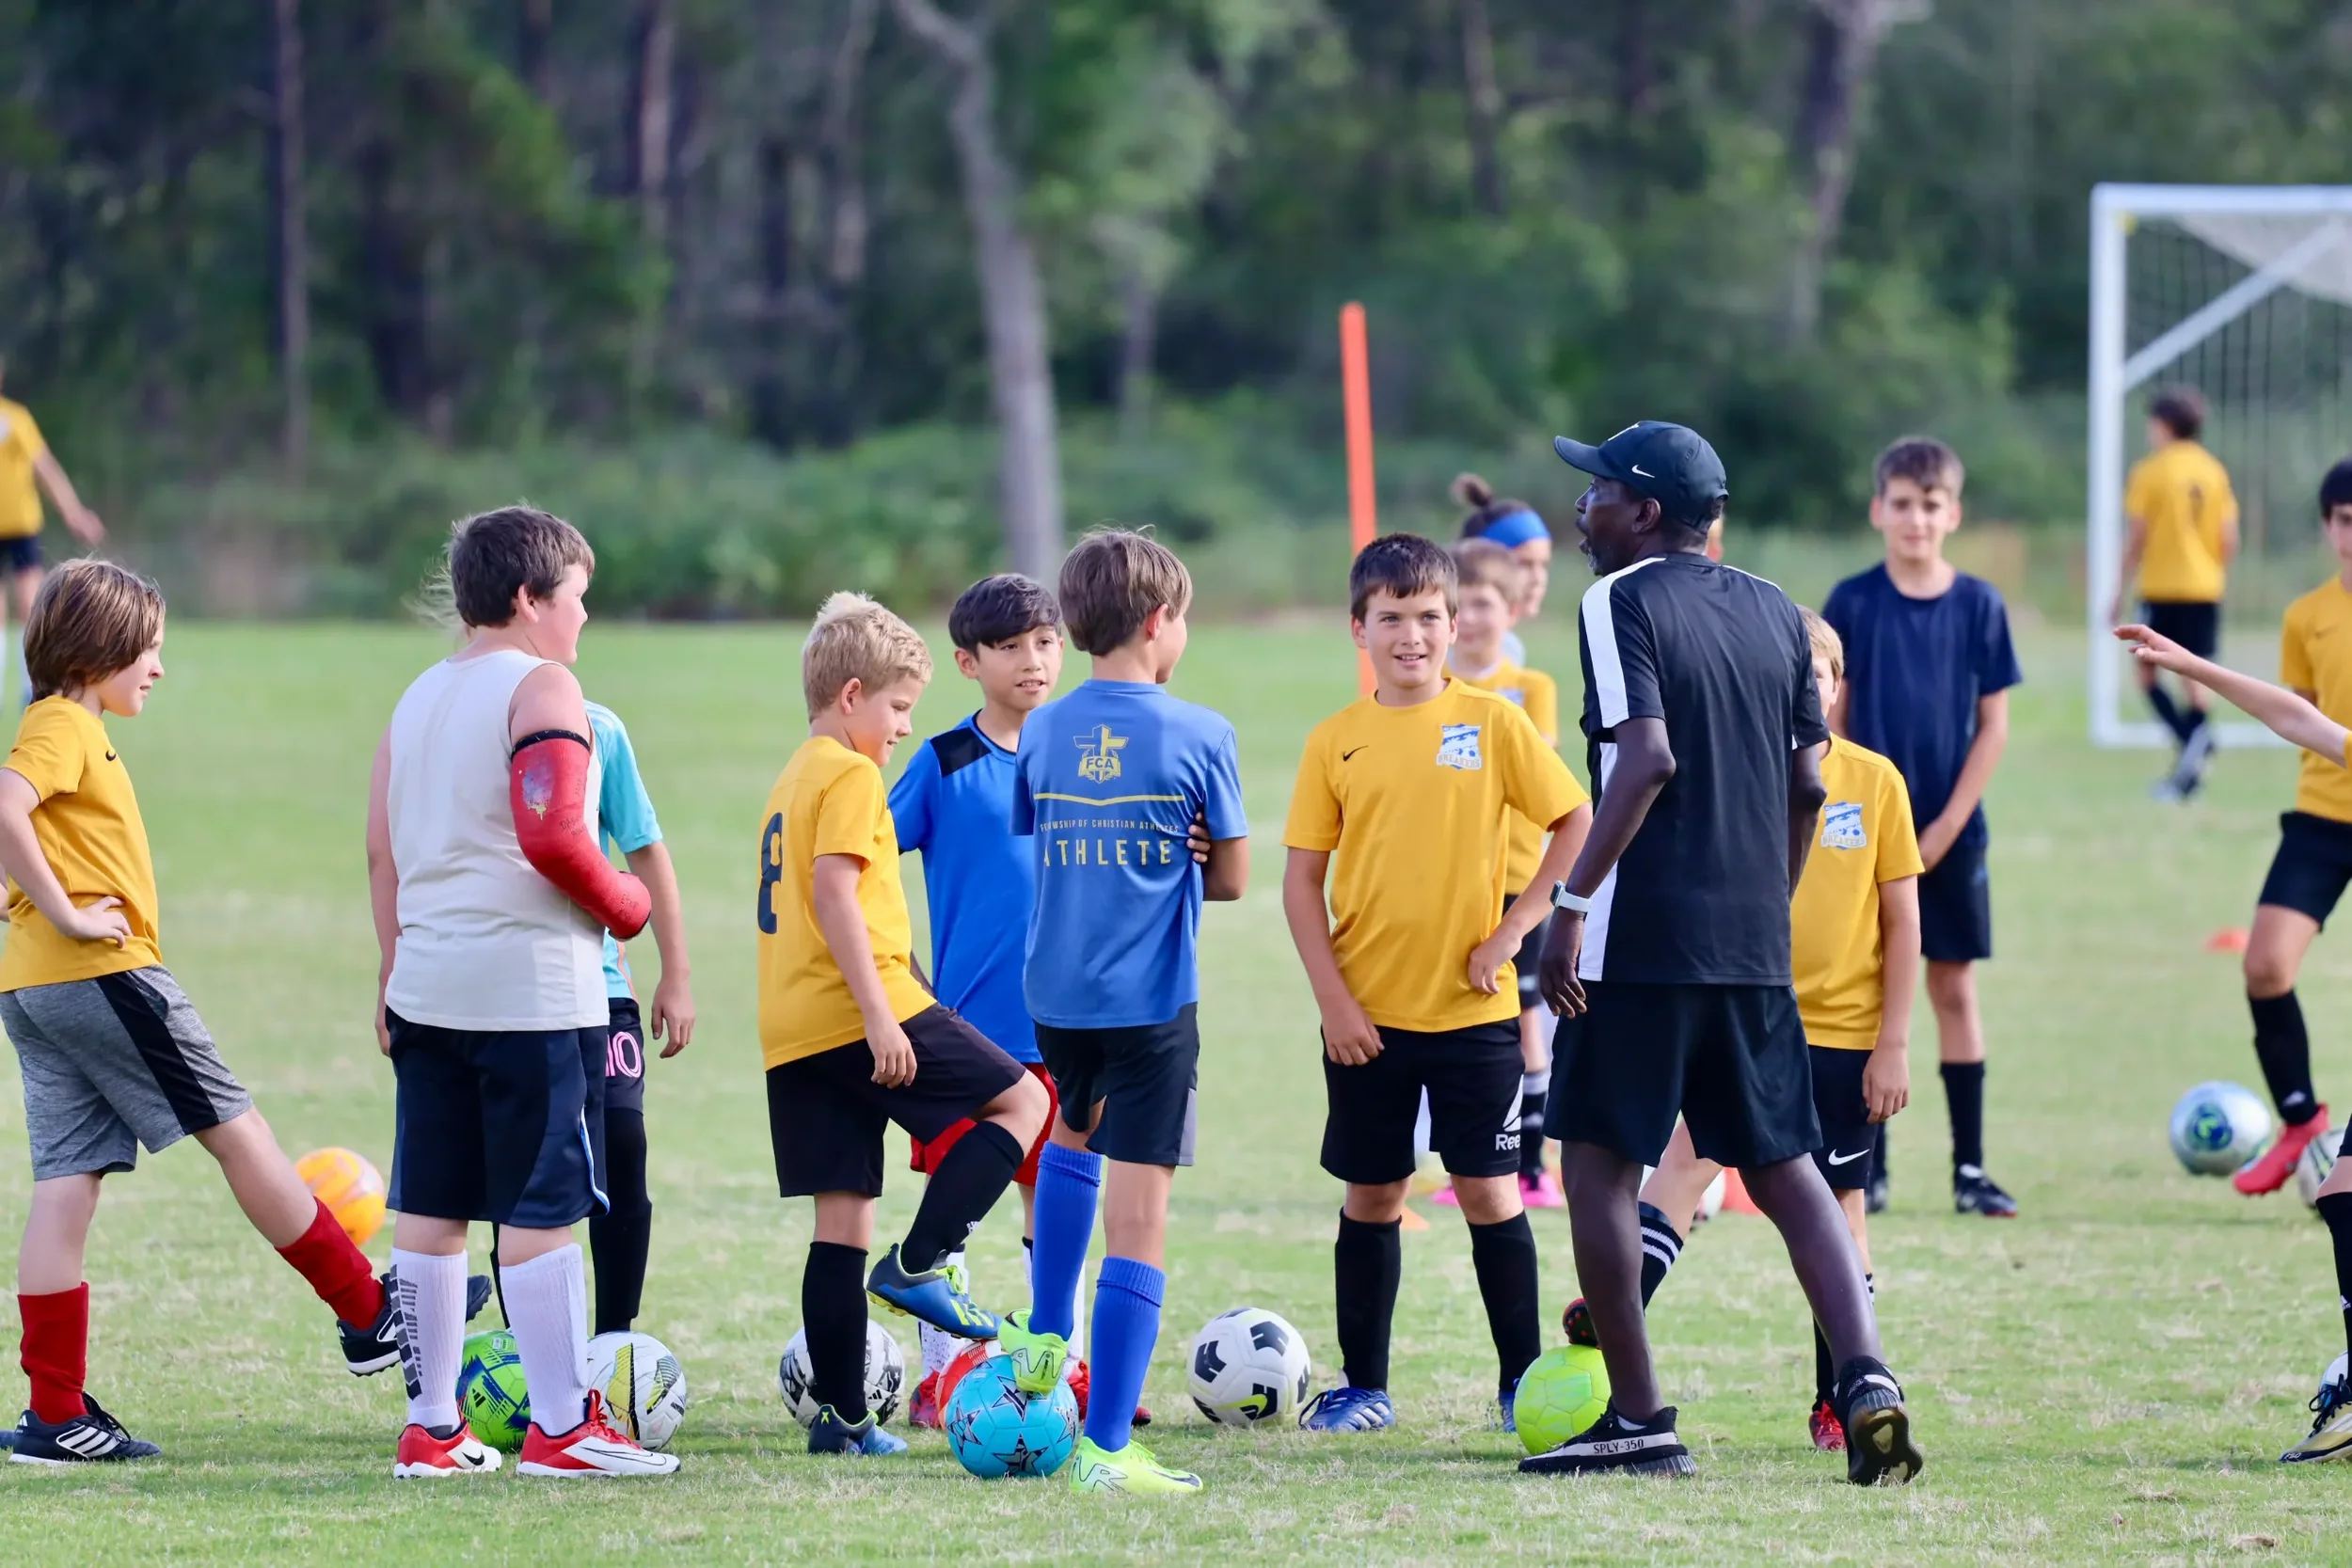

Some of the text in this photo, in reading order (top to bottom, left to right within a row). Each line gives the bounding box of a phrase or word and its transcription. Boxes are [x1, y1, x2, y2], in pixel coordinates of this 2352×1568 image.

[1086, 757, 1115, 769] FCA
[1040, 820, 1075, 832] FEOWSHIP
[1078, 819, 1089, 829] OF
[1091, 819, 1135, 830] CHRISTIAN
[1593, 1438, 1645, 1454] SPLY-350
